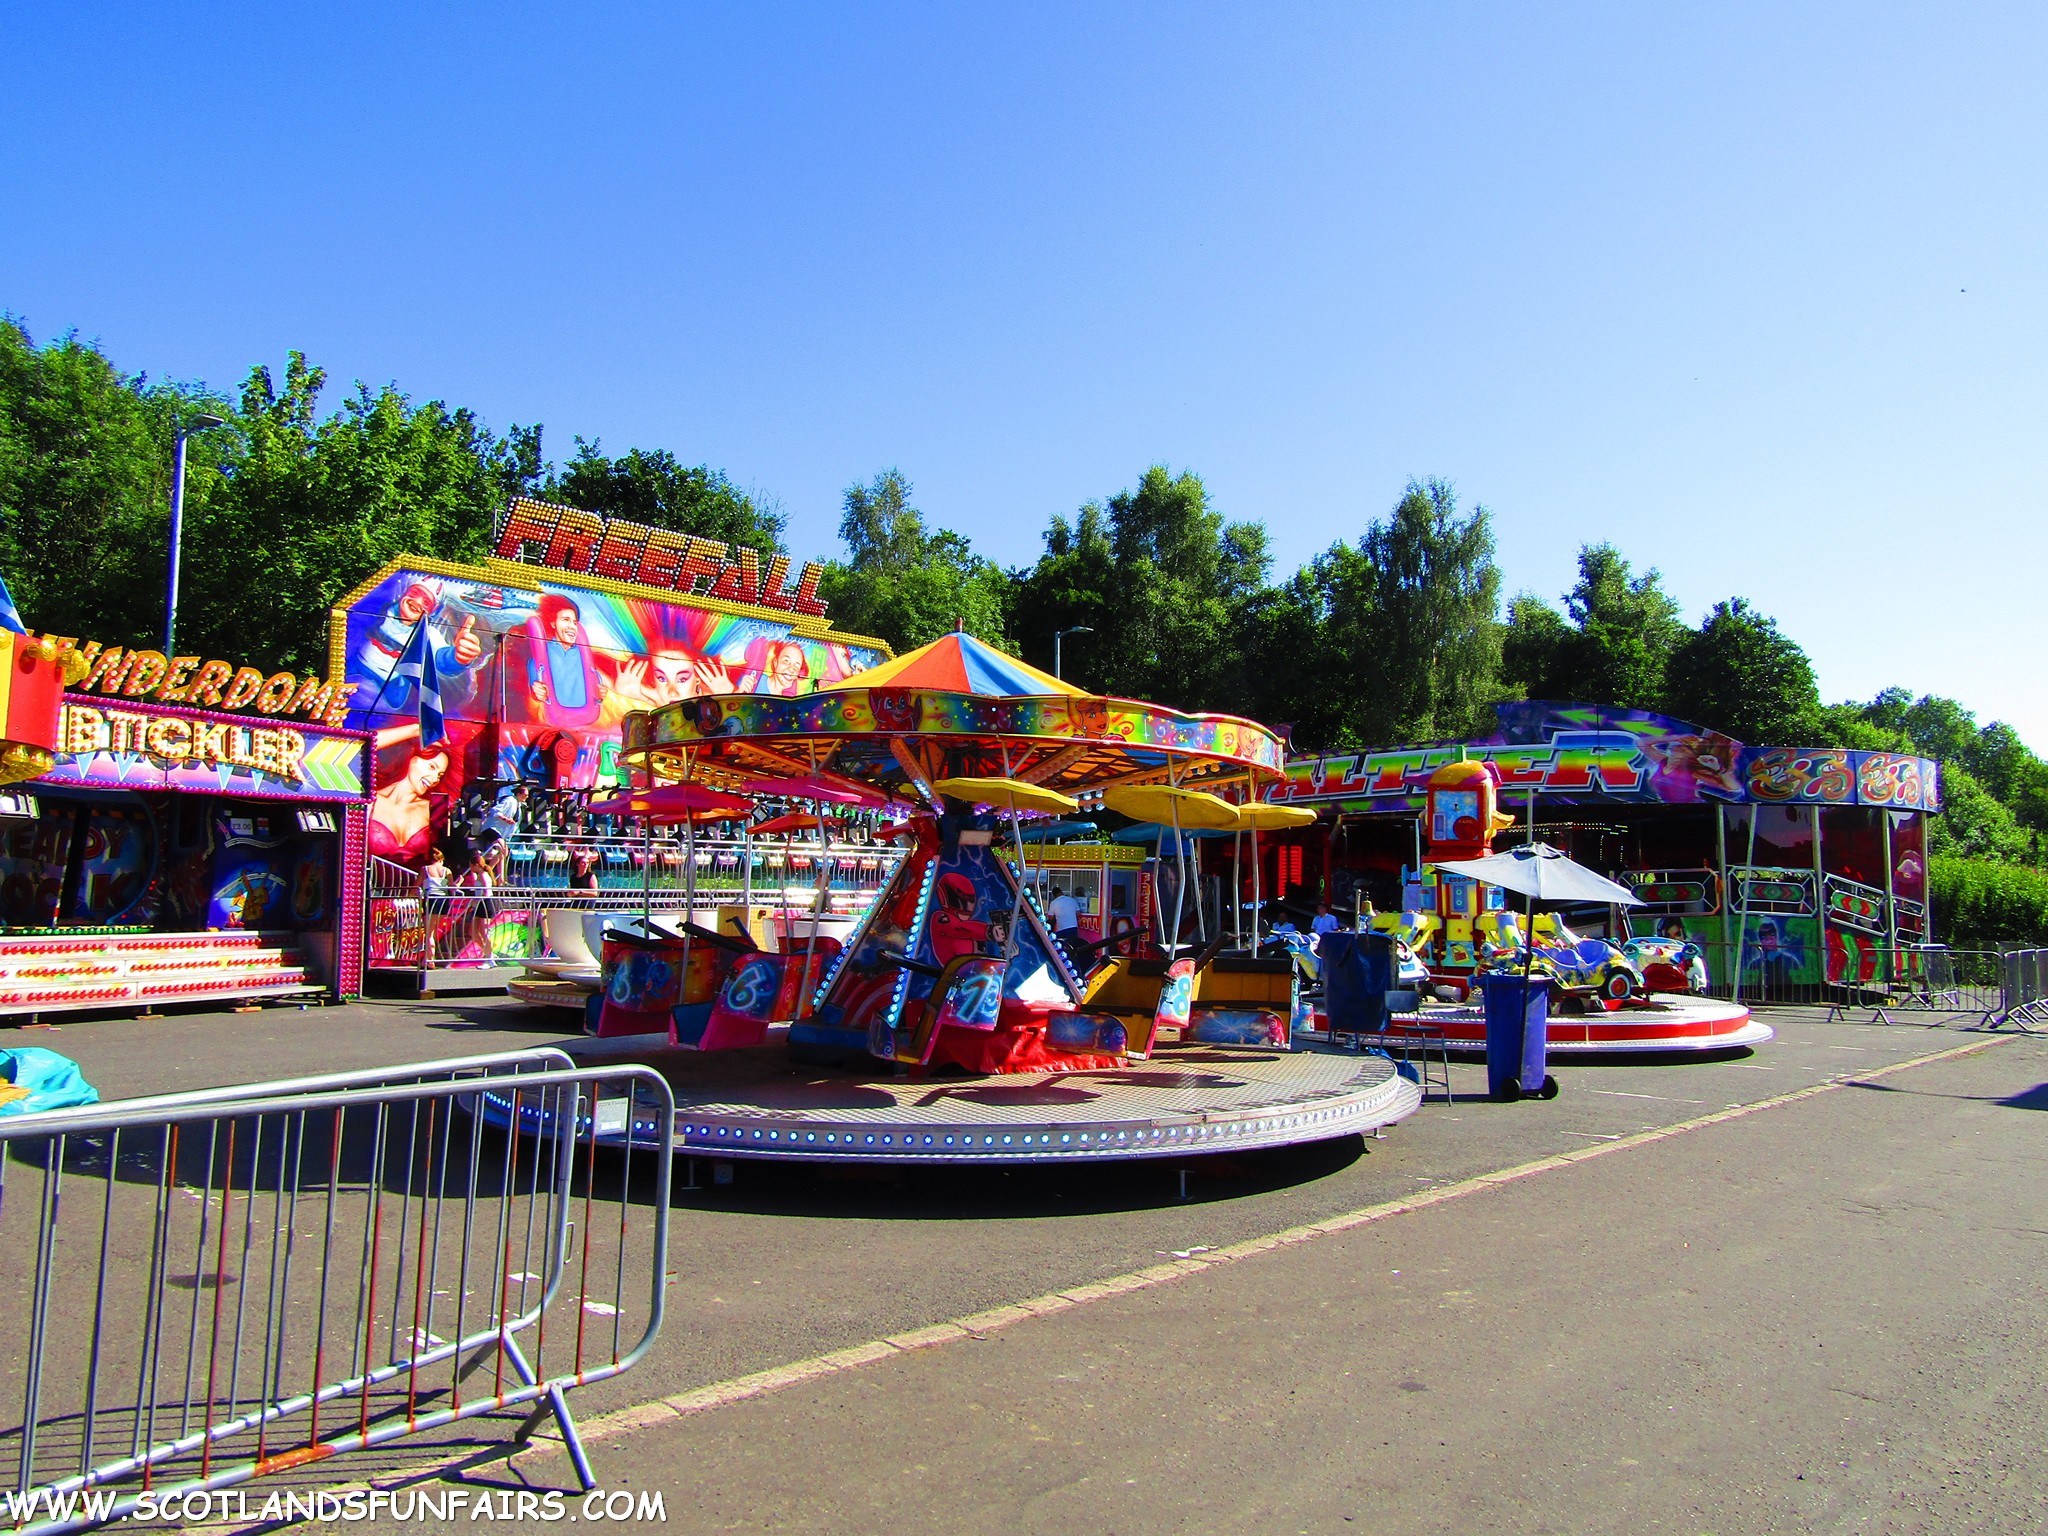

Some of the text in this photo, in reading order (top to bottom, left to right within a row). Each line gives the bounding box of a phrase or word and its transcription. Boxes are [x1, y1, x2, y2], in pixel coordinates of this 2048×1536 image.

[491, 496, 829, 618] FREEFALL
[27, 628, 359, 723] NDERDOME
[1216, 731, 1647, 806] ALTER
[0, 823, 130, 867] EADY
[0, 870, 139, 914] OCK
[727, 956, 762, 1010] 6
